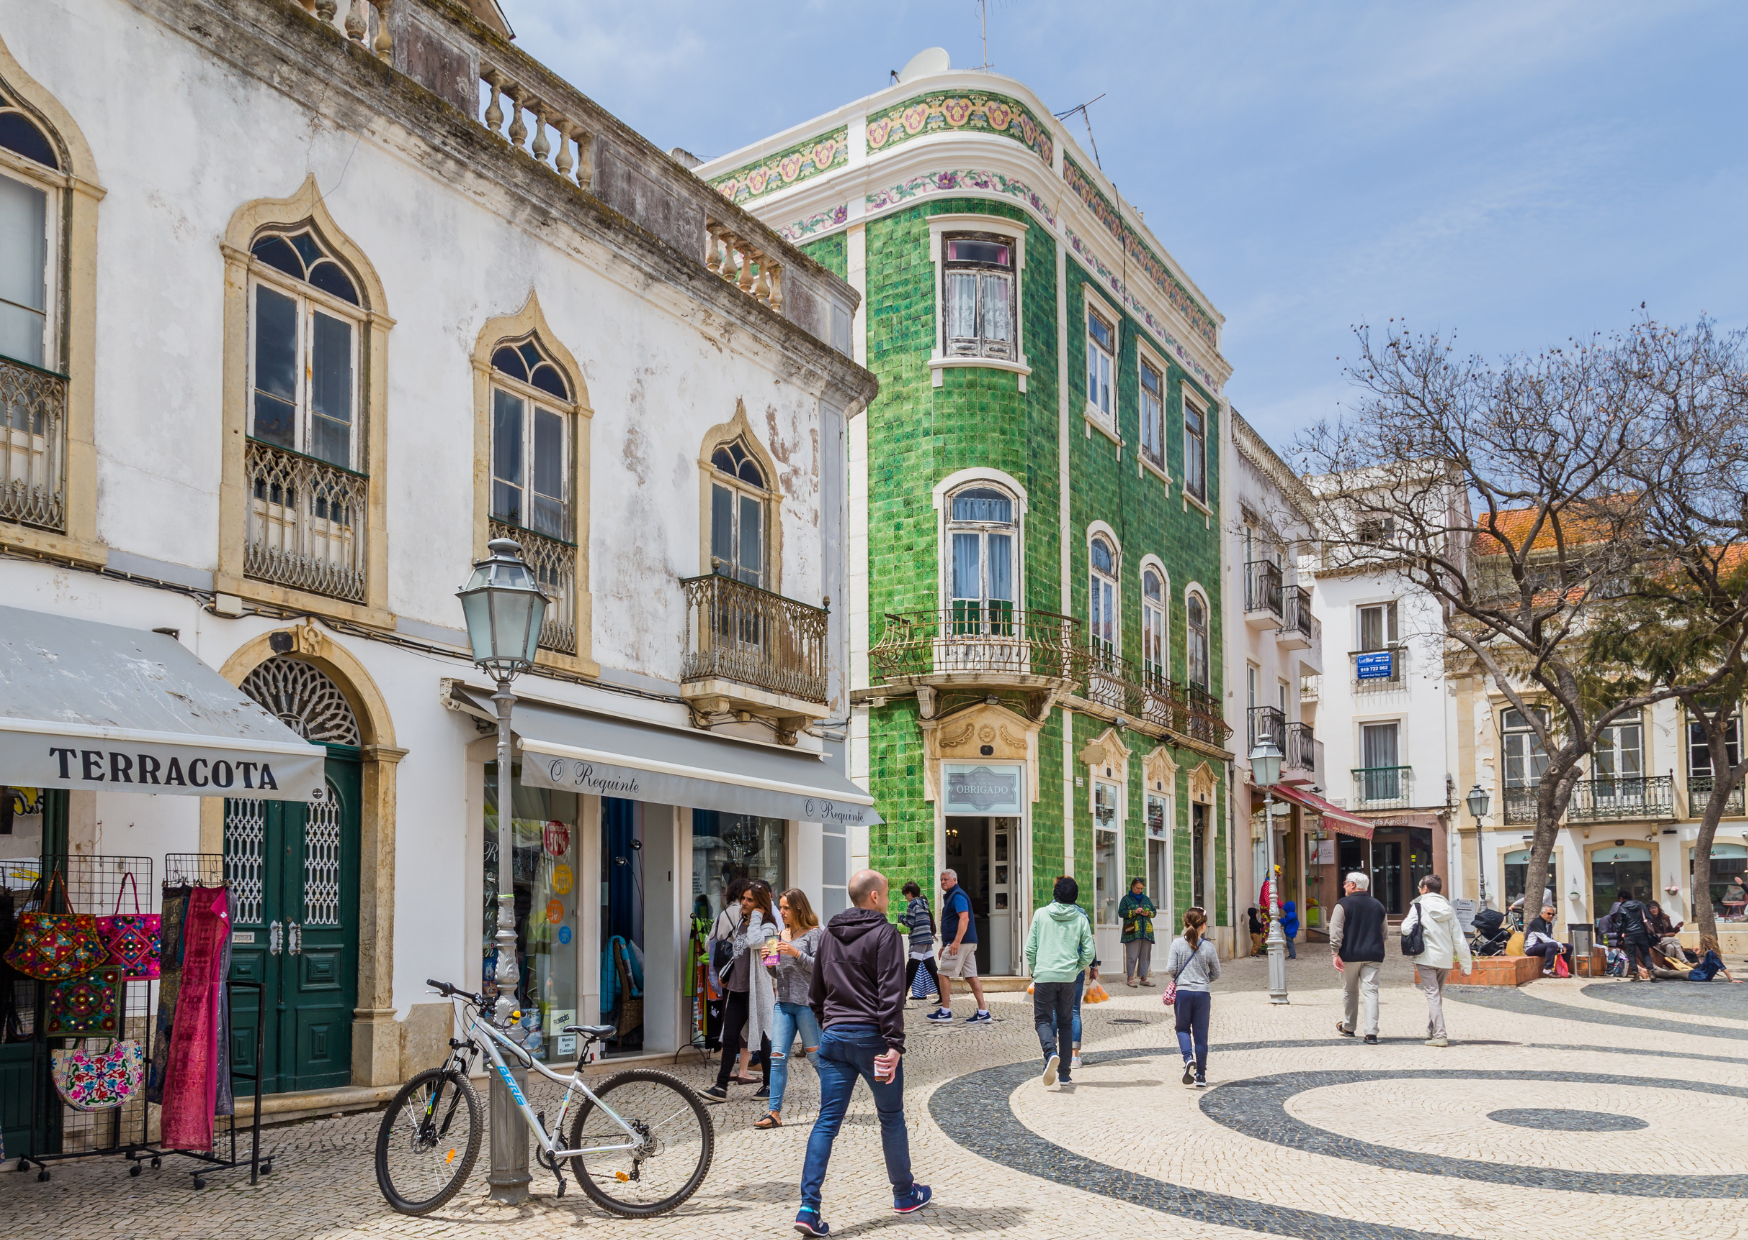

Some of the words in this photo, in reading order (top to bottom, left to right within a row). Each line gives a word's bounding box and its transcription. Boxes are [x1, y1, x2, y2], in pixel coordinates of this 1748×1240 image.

[49, 747, 278, 790] TERRACOTA
[548, 759, 565, 782] O
[574, 762, 639, 793] Requinte
[956, 785, 1008, 795] OBRIGADO
[804, 799, 815, 817] O
[820, 800, 864, 823] Requinte
[497, 1065, 526, 1106] BERG
